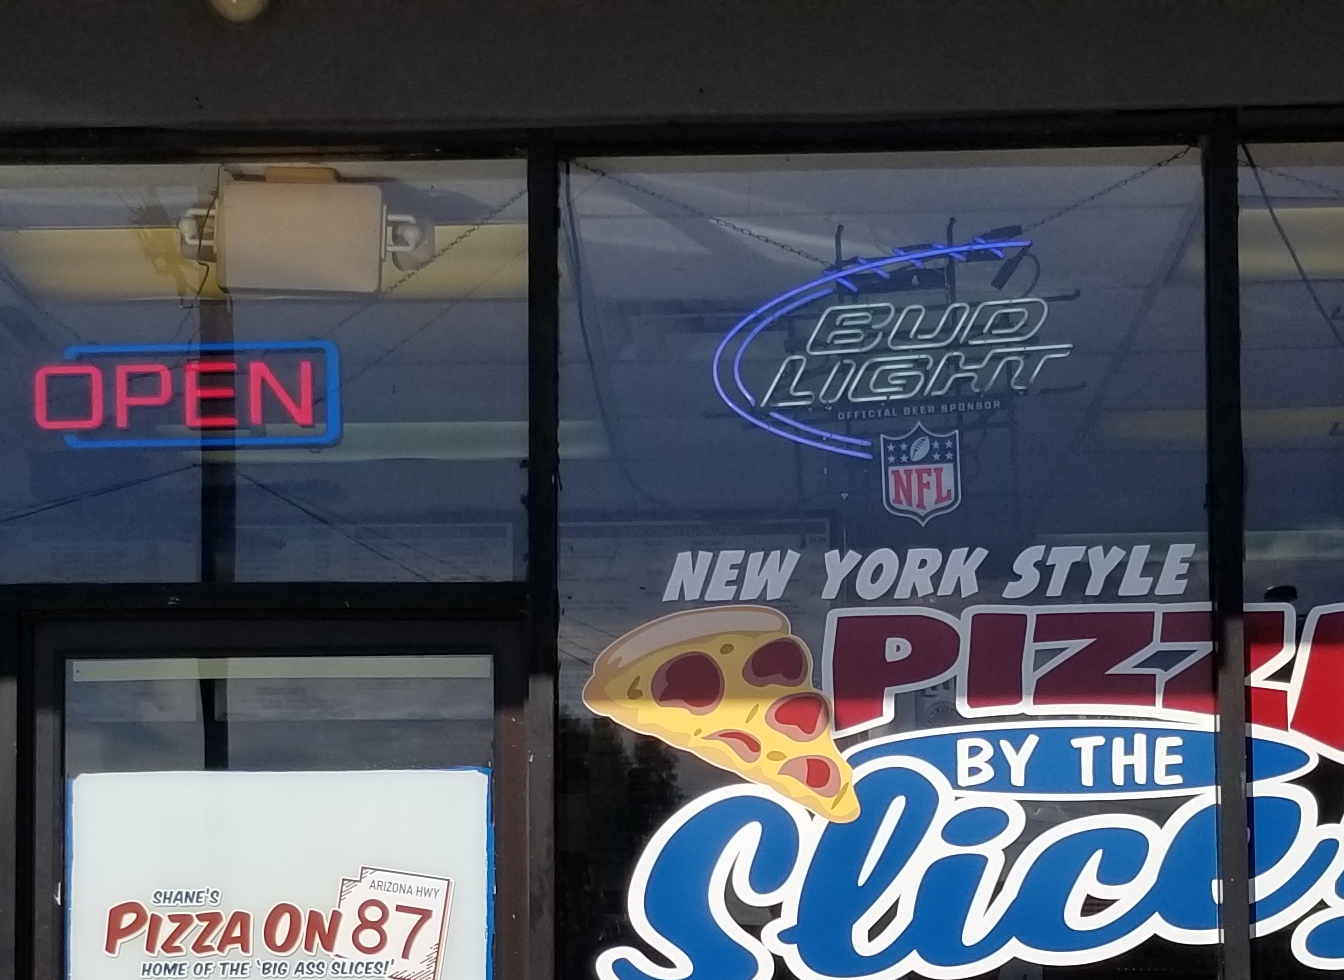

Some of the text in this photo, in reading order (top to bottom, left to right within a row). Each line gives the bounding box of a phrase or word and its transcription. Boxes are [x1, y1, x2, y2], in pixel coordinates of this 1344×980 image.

[806, 298, 1048, 355] BUD
[35, 361, 314, 430] OPEN
[759, 344, 1074, 408] LIGHT
[837, 400, 1002, 421] OFFICIAL BEER SPONSOR
[892, 466, 952, 511] NFL
[662, 548, 802, 602] NEW
[821, 545, 989, 600] YORK
[1003, 543, 1196, 599] STYLE
[956, 734, 1184, 788] BY THE
[152, 889, 220, 905] SHANE'S
[369, 879, 440, 900] ARIZONA HWY
[106, 901, 252, 955] PIZZA
[352, 898, 434, 960] 87
[142, 962, 187, 977] HOME
[193, 962, 213, 977] OF
[220, 962, 249, 976] THE
[294, 962, 324, 976] ASS
